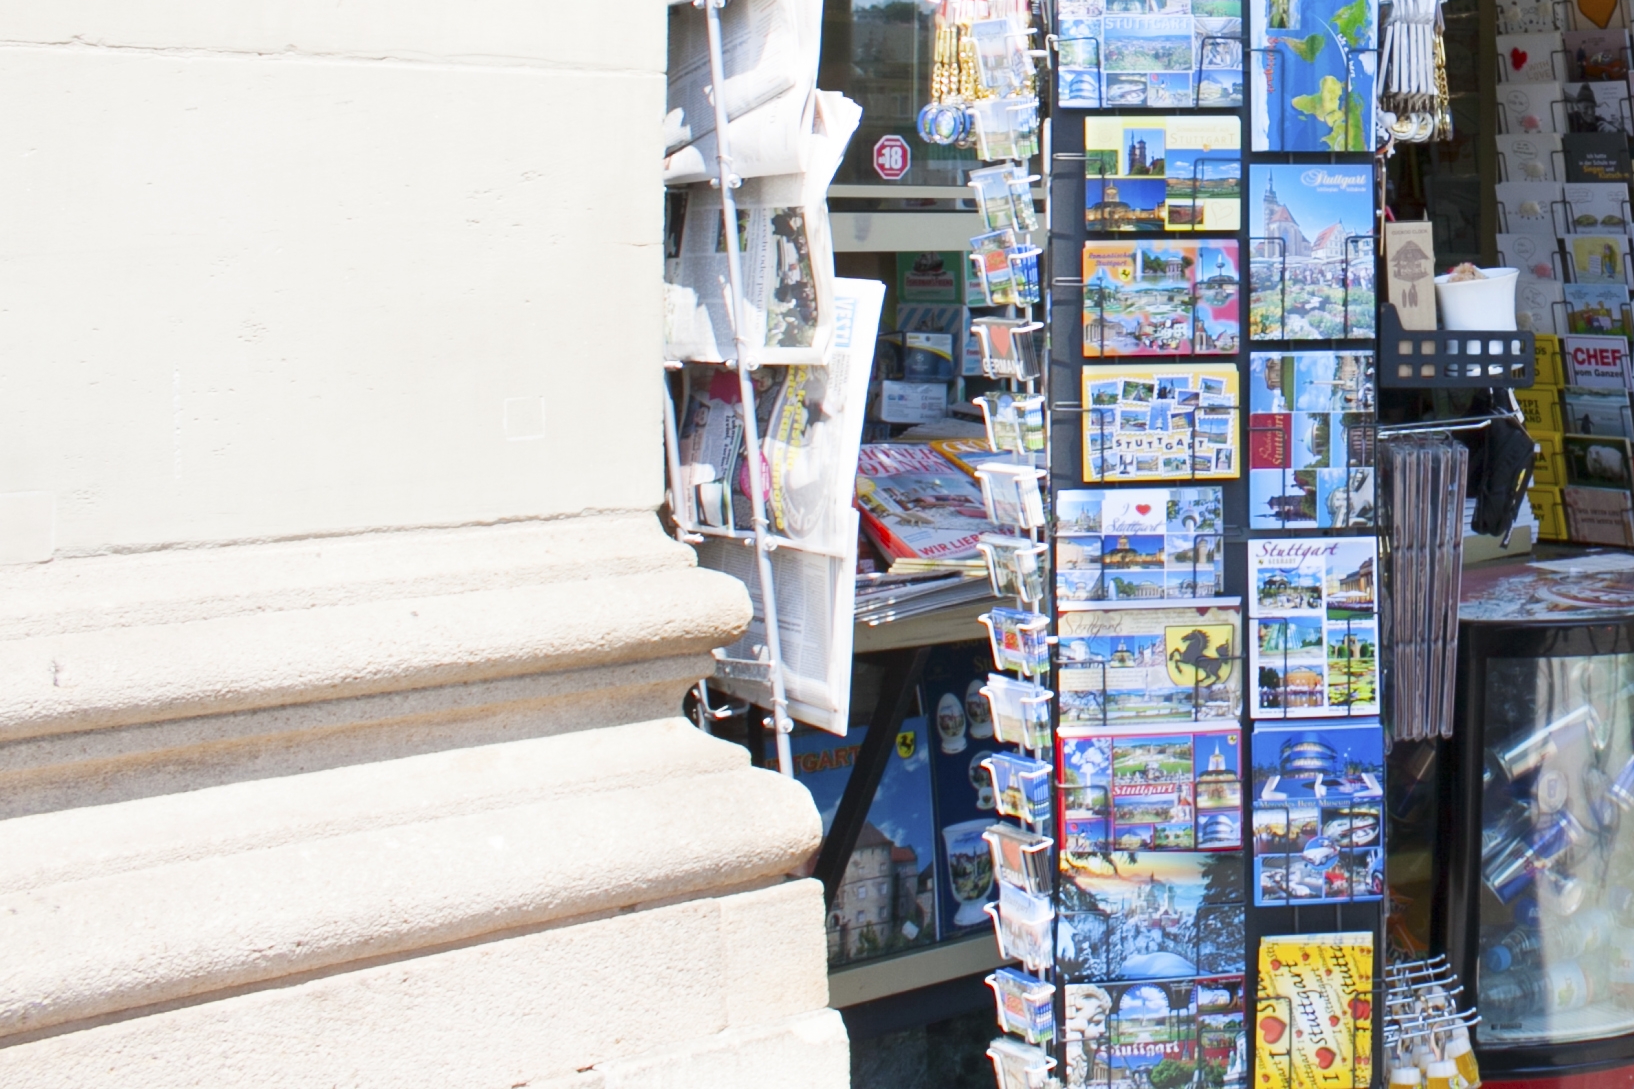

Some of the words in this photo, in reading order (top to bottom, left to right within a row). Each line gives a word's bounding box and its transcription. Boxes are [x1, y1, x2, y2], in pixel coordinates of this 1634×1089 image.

[1105, 17, 1190, 30] STUTTGART
[1529, 61, 1549, 71] WITH
[1526, 69, 1552, 82] LOVE
[1170, 133, 1236, 145] STUTTGART
[1301, 168, 1367, 190] Stuttgart
[1572, 347, 1622, 367] CHEF
[1574, 369, 1592, 377] vom
[1522, 408, 1540, 416] AKA
[1524, 415, 1543, 424] AND
[858, 445, 940, 461] HÖNER
[858, 461, 956, 477] OHNEN
[1104, 520, 1165, 536] Stuttgart
[918, 541, 950, 557] WIR
[1256, 541, 1339, 573] Stuttgart
[1112, 781, 1176, 797] Stuttgart
[1258, 799, 1296, 809] Mercedes
[1297, 799, 1316, 808] Benz
[1316, 797, 1351, 808] Museum
[1281, 958, 1329, 1046] Stuttgart
[1100, 1039, 1180, 1058] Stuttgart
